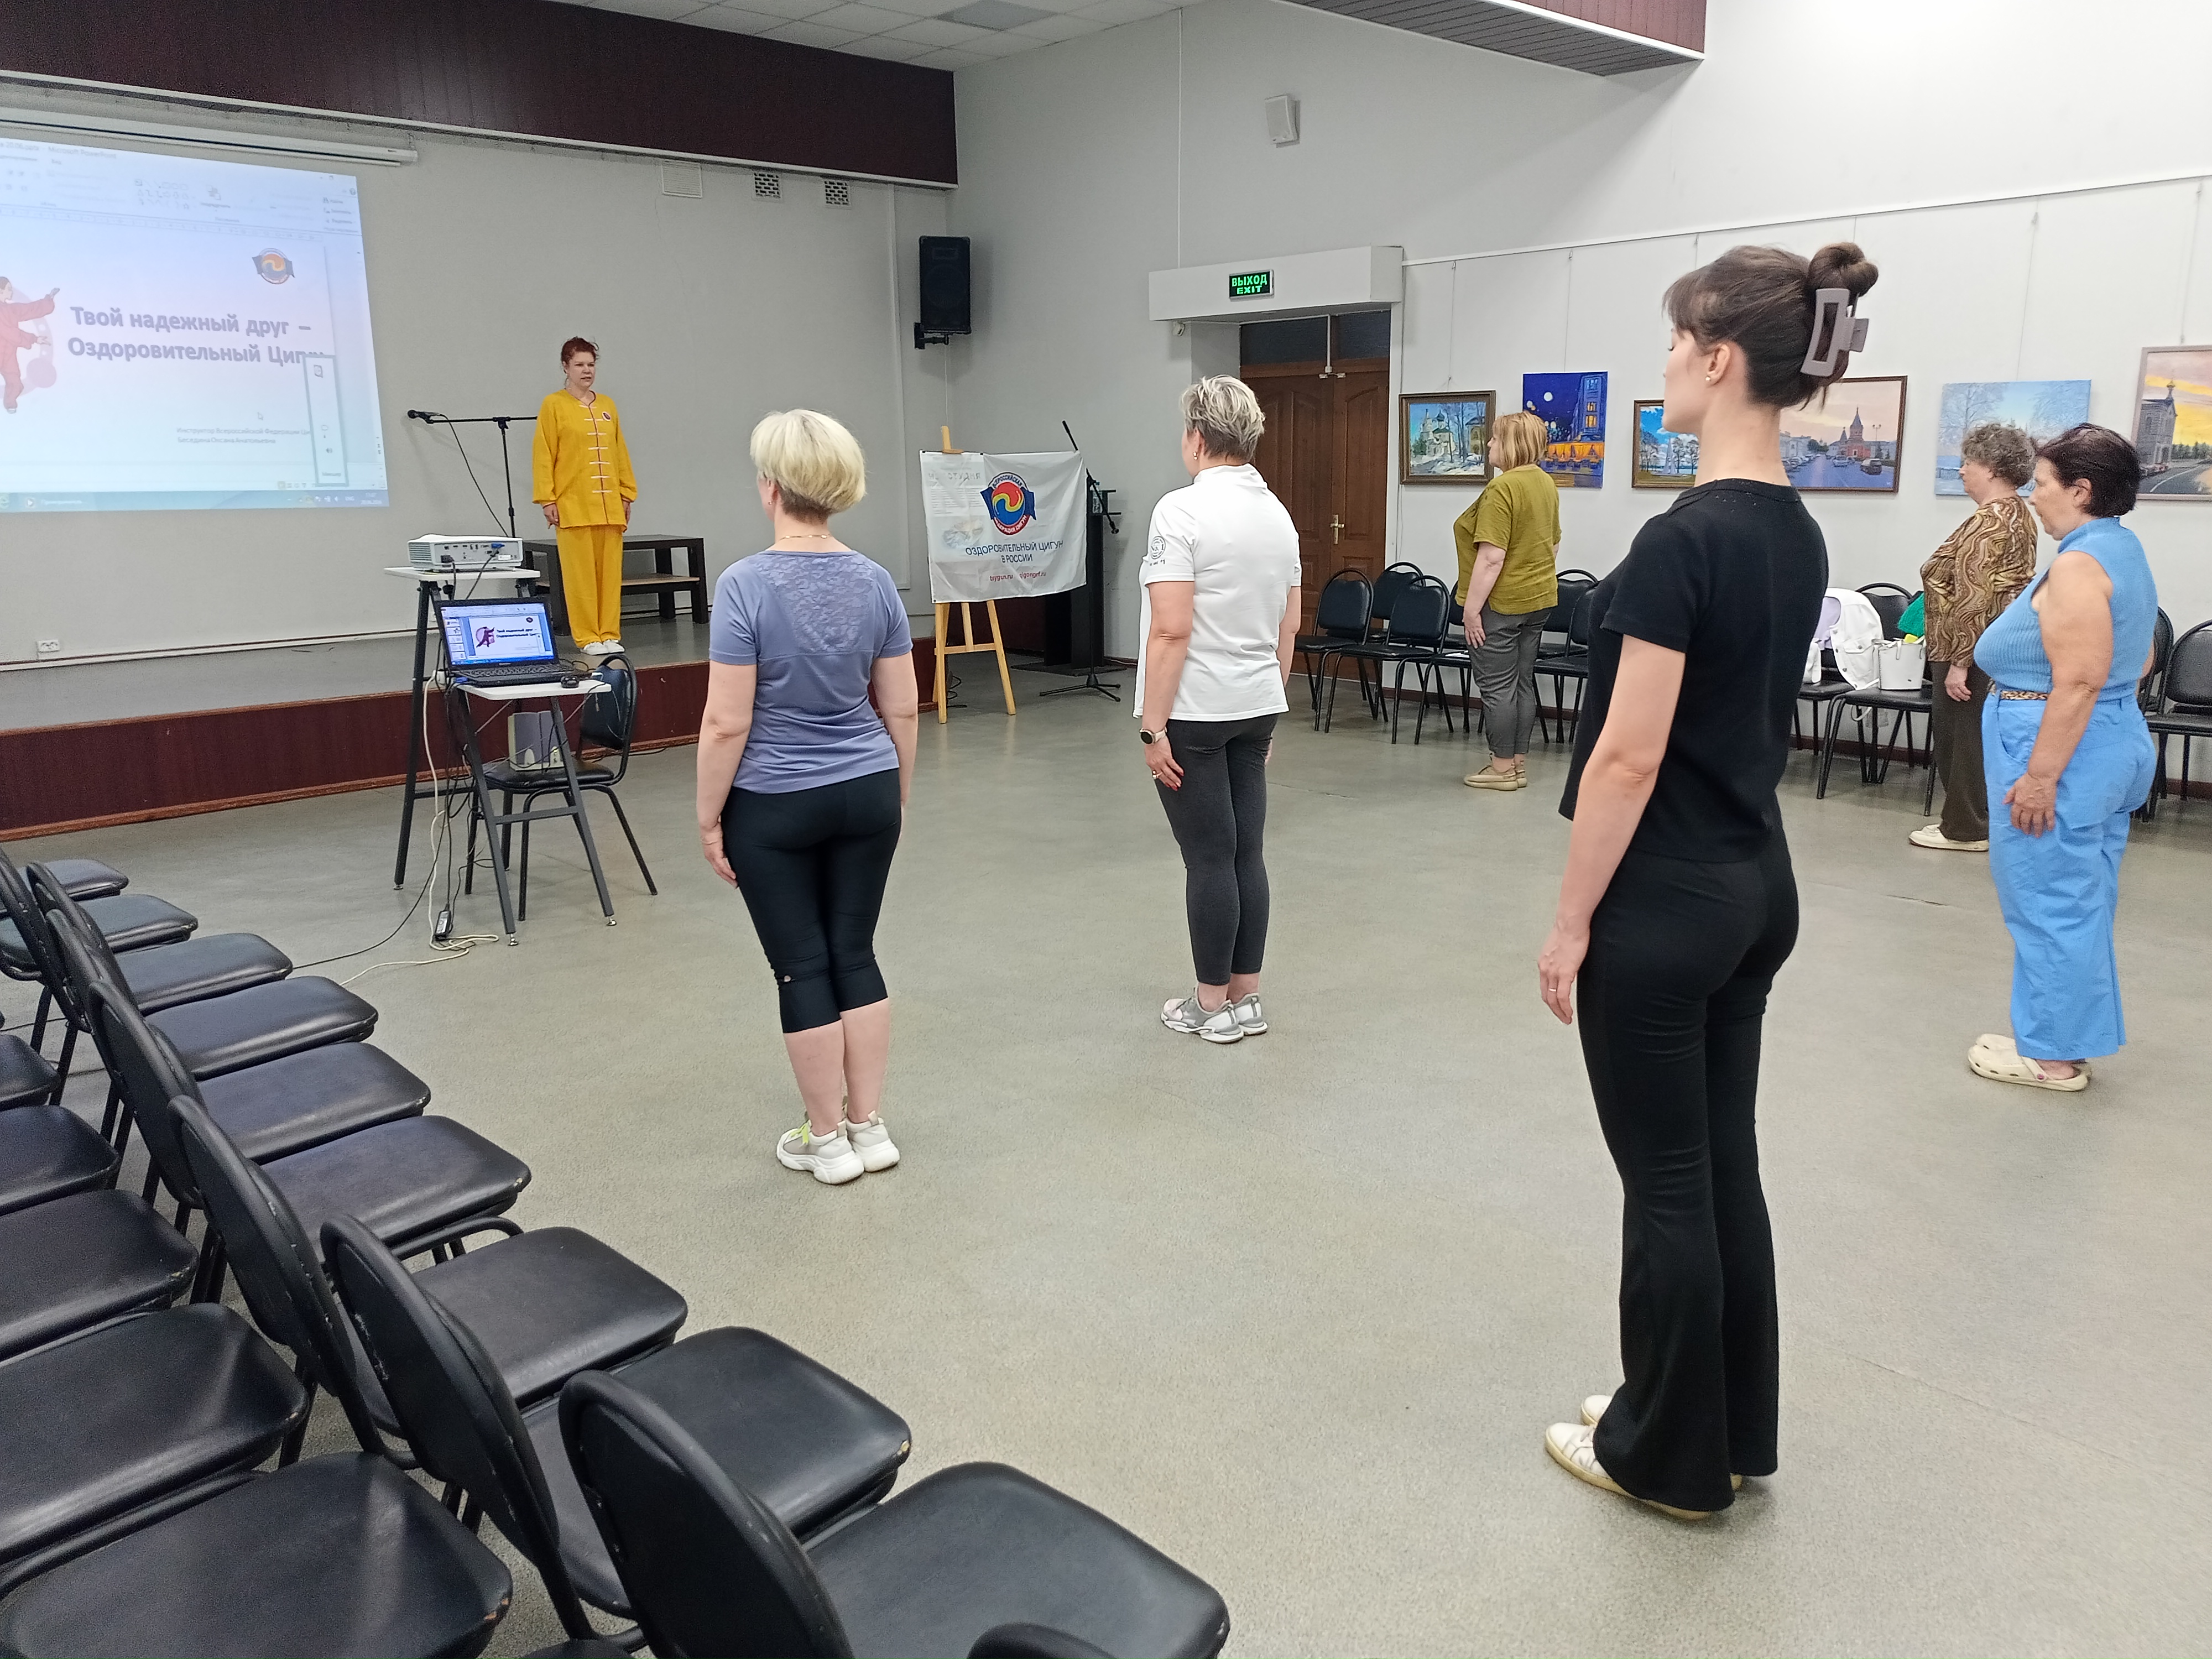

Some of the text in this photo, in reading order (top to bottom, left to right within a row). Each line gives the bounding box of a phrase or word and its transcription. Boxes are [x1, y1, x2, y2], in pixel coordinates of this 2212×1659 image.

[1232, 274, 1267, 287] ВЫХОД
[1237, 285, 1262, 294] EXIT
[70, 306, 124, 327] Твой
[129, 313, 239, 333] надежный
[246, 319, 289, 338] друг
[67, 337, 324, 367] Оздоровительный Циг
[965, 540, 1063, 556] ОЗДОРОВИТЕЛЬНЫЙ ЦИГУН
[1006, 554, 1033, 562] РОССИИ
